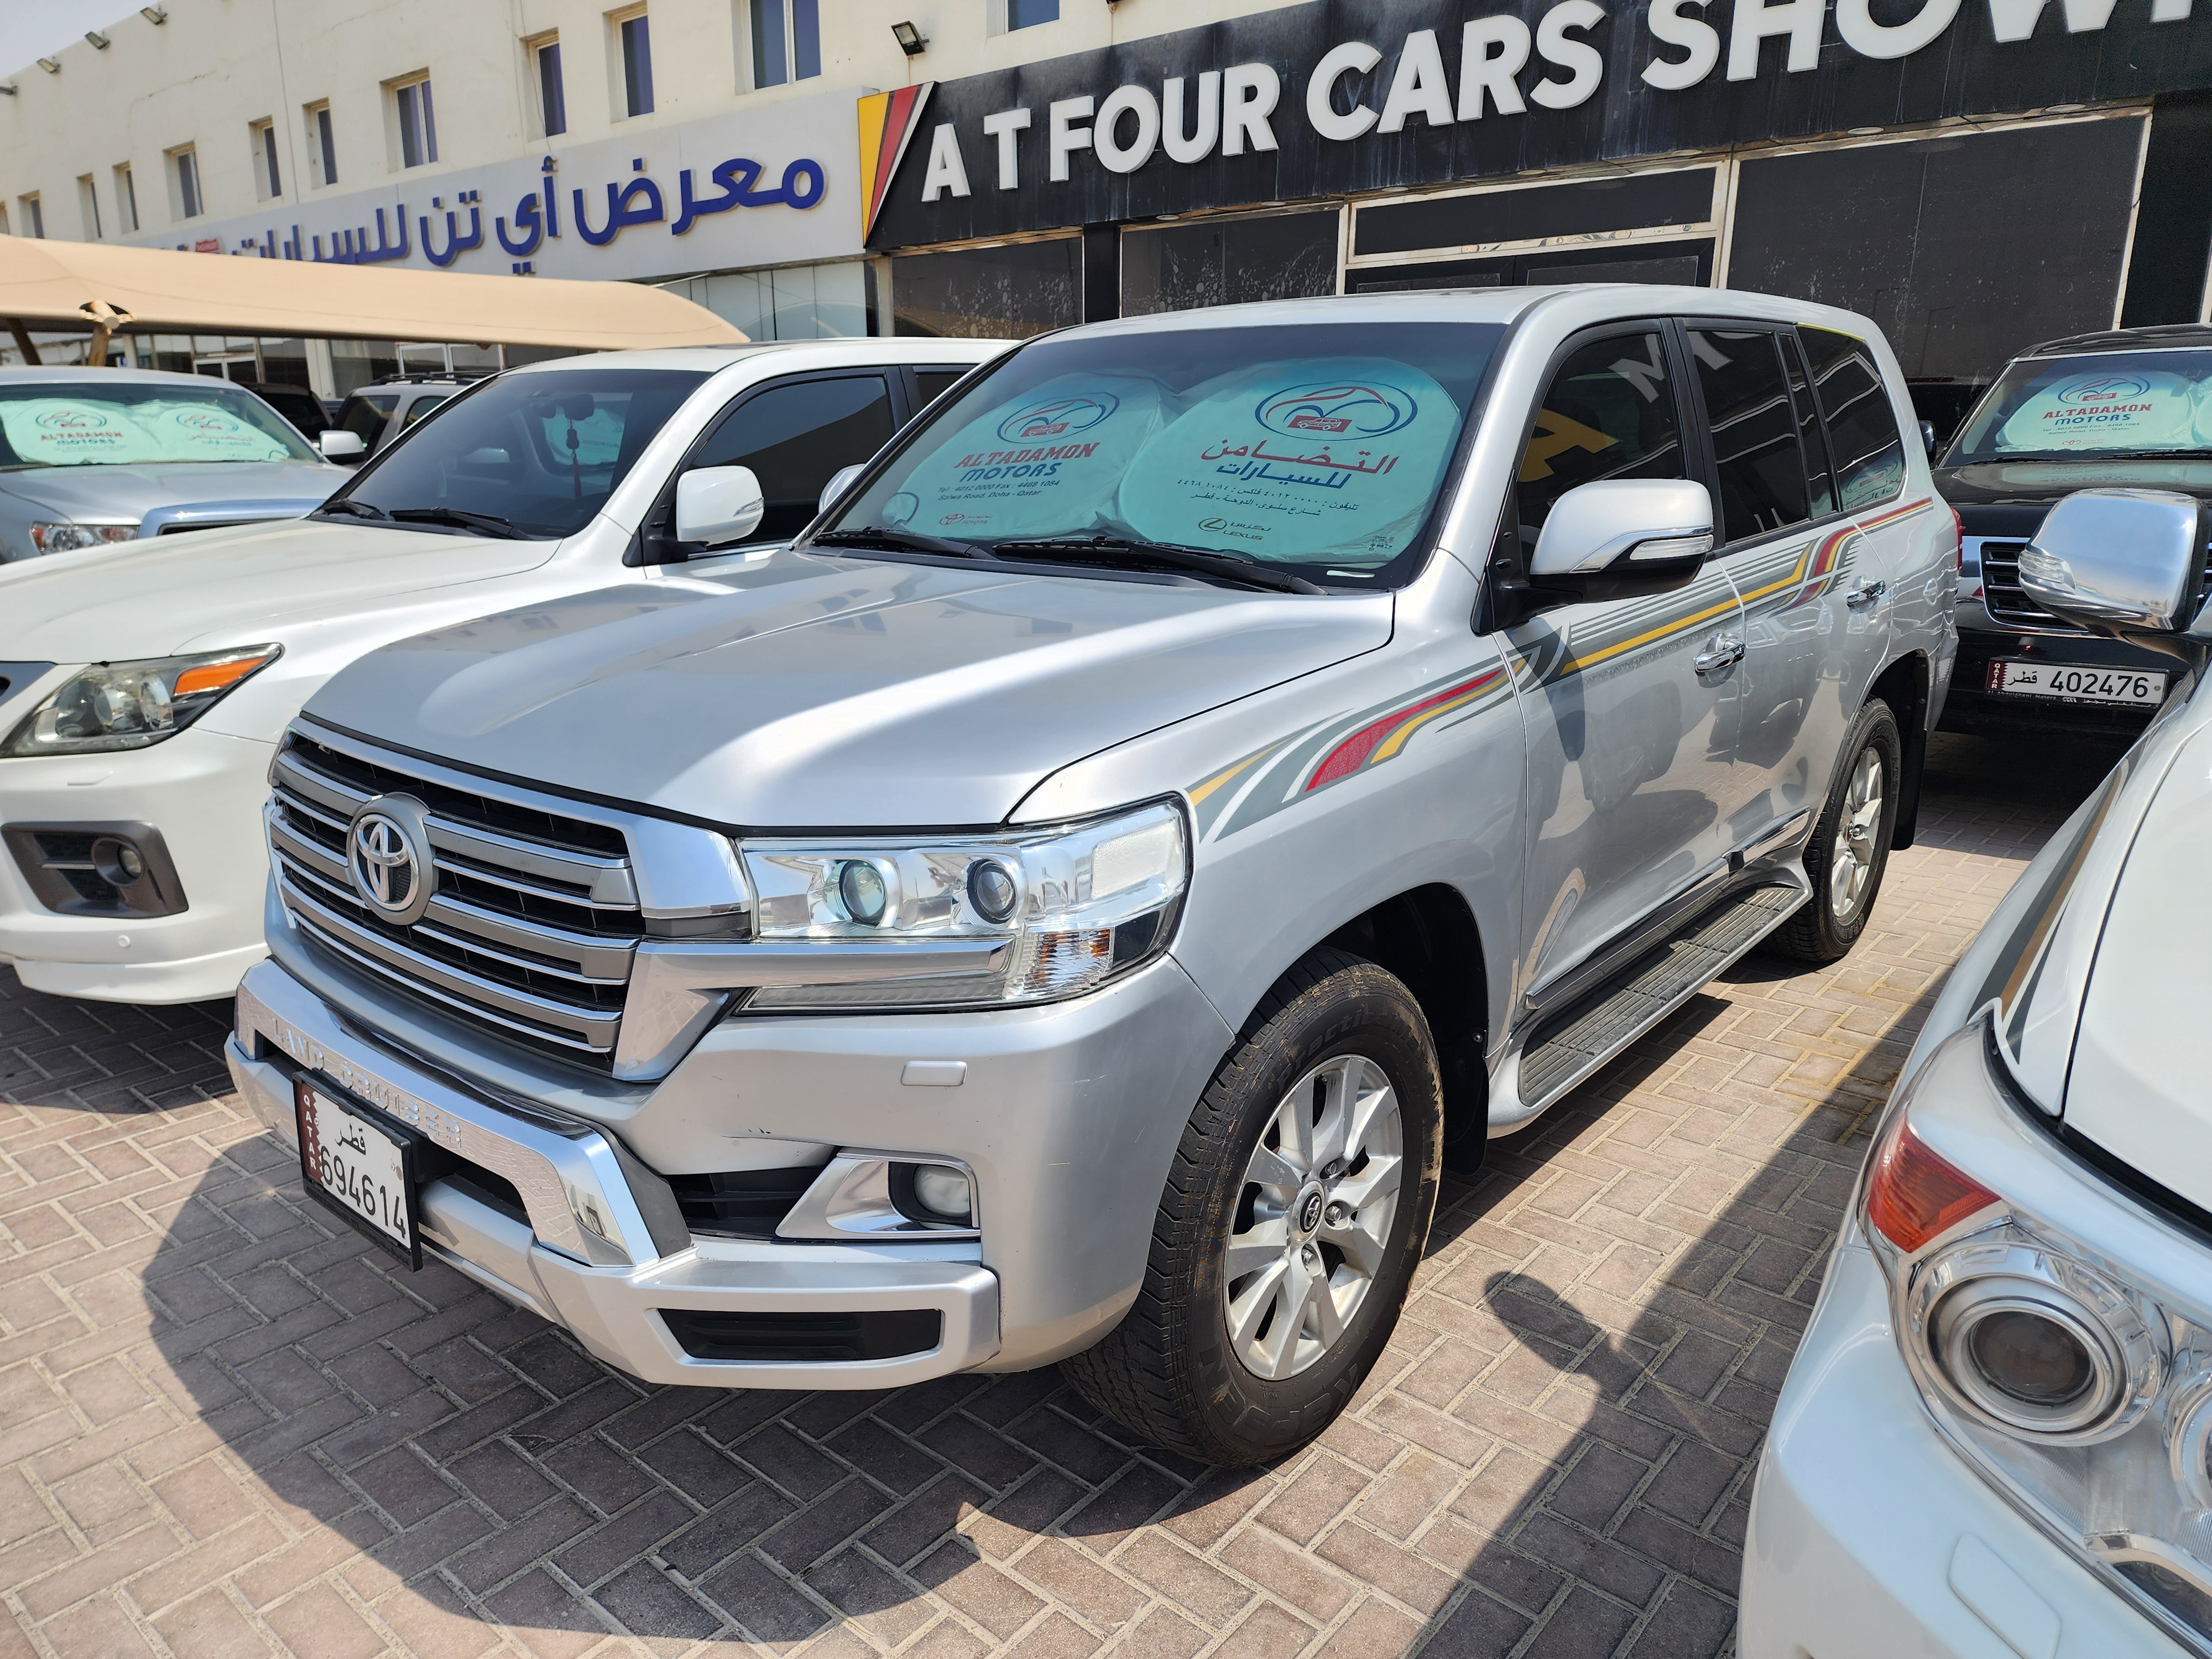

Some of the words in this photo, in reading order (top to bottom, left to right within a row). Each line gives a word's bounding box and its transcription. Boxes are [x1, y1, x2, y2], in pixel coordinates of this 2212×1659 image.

[921, 122, 971, 203] A
[983, 107, 1031, 191] T
[1049, 62, 1281, 182] FOUR
[1306, 6, 1608, 142] CARS
[1640, 0, 2193, 90] SHO
[495, 155, 561, 275] أي
[573, 154, 827, 249] معرض
[420, 190, 482, 266] تن
[2042, 404, 2153, 420] ALTADAMON
[2054, 414, 2132, 425] MOTORS
[954, 442, 1100, 469] ALTADAMON
[1201, 439, 1400, 476] التضامن
[959, 462, 1062, 482] MOTORS
[1216, 461, 1353, 489] للسيارات
[1223, 530, 1264, 540] LEXUS
[1991, 663, 2001, 689] QATAR
[2006, 670, 2038, 686] قطر
[2049, 670, 2148, 697] 402476
[304, 1094, 317, 1170] QATAR
[335, 1123, 366, 1156] قطر
[321, 1145, 406, 1240] 694614
